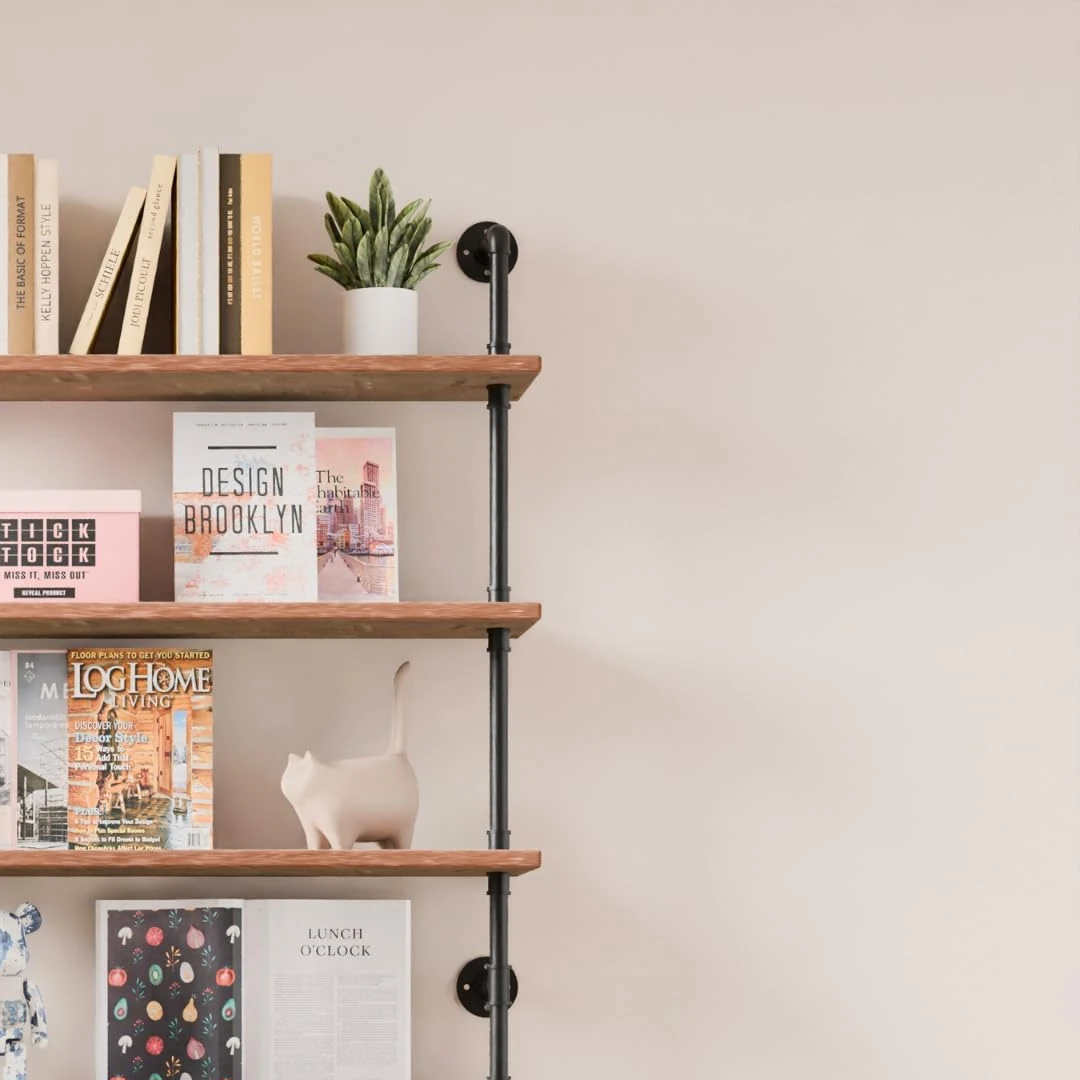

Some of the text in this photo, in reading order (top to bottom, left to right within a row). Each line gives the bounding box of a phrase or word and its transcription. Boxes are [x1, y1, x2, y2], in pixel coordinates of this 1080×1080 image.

[16, 195, 26, 310] THE BASIC OF FORMAT
[40, 203, 52, 322] KELLY HOPPEN STYLE
[134, 258, 151, 302] PICOULT
[202, 467, 284, 497] DESIGN
[315, 469, 344, 484] The
[184, 504, 303, 535] BROOKLYN
[0, 523, 90, 539] TICK
[0, 547, 90, 563] TOCK
[4, 571, 86, 581] MISS IT, MISS OUT
[71, 651, 210, 659] FLOOR PLANS TO GET YOU STARTED
[113, 695, 171, 709] LIVING
[74, 721, 111, 730] DISCOVER
[115, 732, 149, 746] Style
[74, 745, 94, 761] 15
[110, 762, 131, 771] Touch
[308, 928, 363, 940] LUNCH
[300, 944, 372, 957] O'CLOCK
